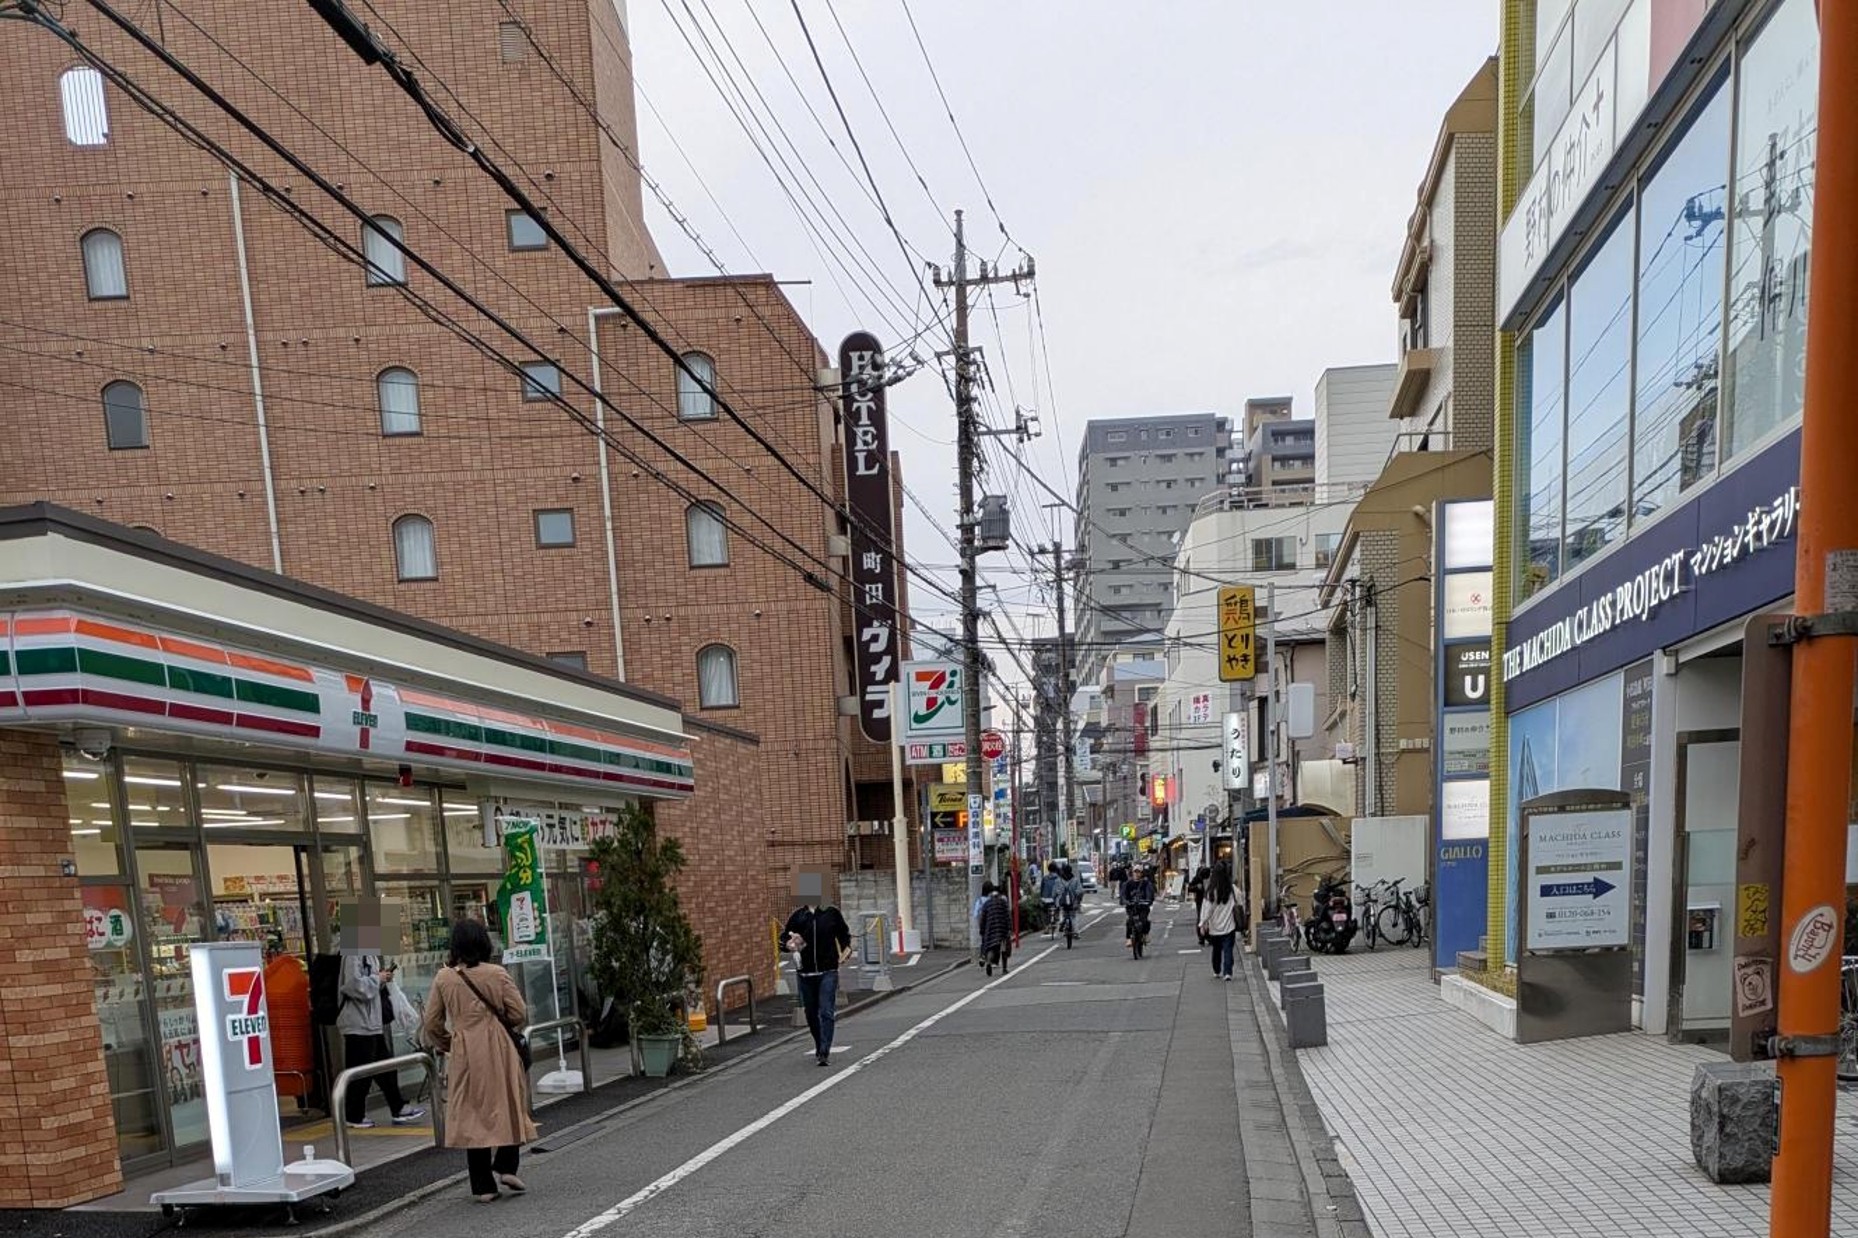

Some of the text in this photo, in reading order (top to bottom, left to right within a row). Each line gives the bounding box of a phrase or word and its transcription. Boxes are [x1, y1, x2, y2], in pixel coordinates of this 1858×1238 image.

[1502, 549, 1684, 682] THE MACHIDA CLASS PROJECT
[1460, 651, 1490, 662] USEN
[1464, 674, 1485, 699] U
[1539, 832, 1588, 844] MACHIDA
[1590, 830, 1622, 840] CLASS
[1551, 884, 1596, 896] 入口はこちら
